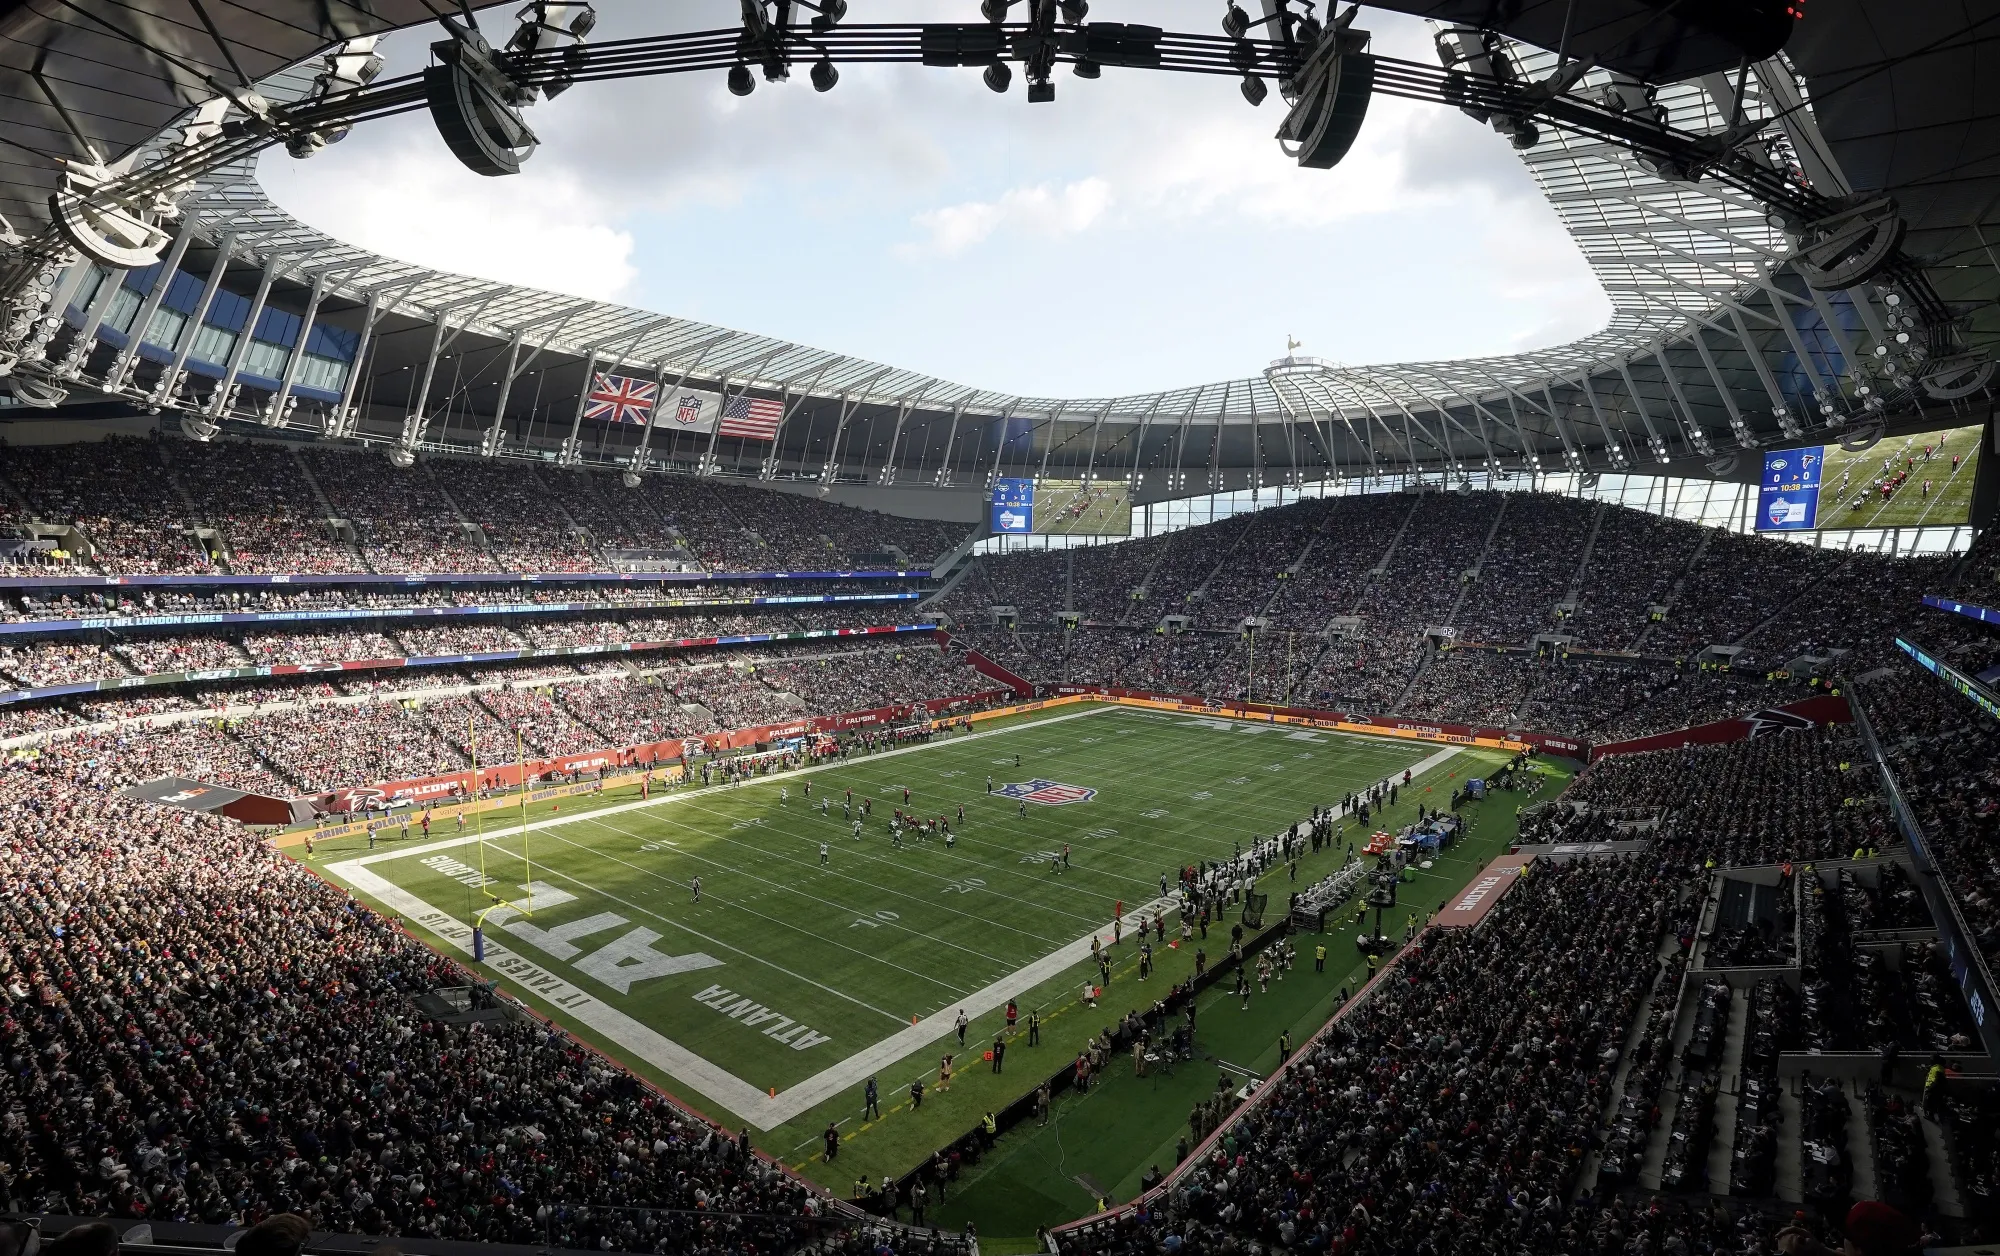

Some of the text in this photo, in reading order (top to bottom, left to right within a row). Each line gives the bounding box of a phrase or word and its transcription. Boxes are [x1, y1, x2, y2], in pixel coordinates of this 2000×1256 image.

[679, 407, 696, 421] NFL
[1773, 474, 1780, 482] 0
[1803, 471, 1809, 480] 0
[82, 614, 223, 628] 2021 NFL LONDON GAMES
[192, 669, 232, 680] JETS
[256, 667, 272, 675] VS
[119, 677, 145, 687] JETS
[1200, 706, 1221, 714] COLOUR
[845, 713, 876, 725] FALCONS
[769, 725, 806, 737] FALCONS
[1398, 723, 1442, 733] FALCONS
[1446, 735, 1476, 743] COLOUR
[1545, 739, 1578, 751] RISE UP
[395, 780, 459, 797] FALCONS
[532, 789, 558, 802] BRING
[315, 824, 351, 841] BRING
[367, 813, 413, 832] COLOUR
[419, 854, 500, 889] FALCONS
[1453, 876, 1502, 911] FALCONS
[418, 912, 450, 928] US
[438, 926, 472, 939] OF
[472, 880, 727, 996] ATL
[496, 958, 564, 995] TAKES
[554, 993, 592, 1010] IT
[1970, 988, 1985, 1027] JETS
[691, 983, 832, 1051] ATLANTA
